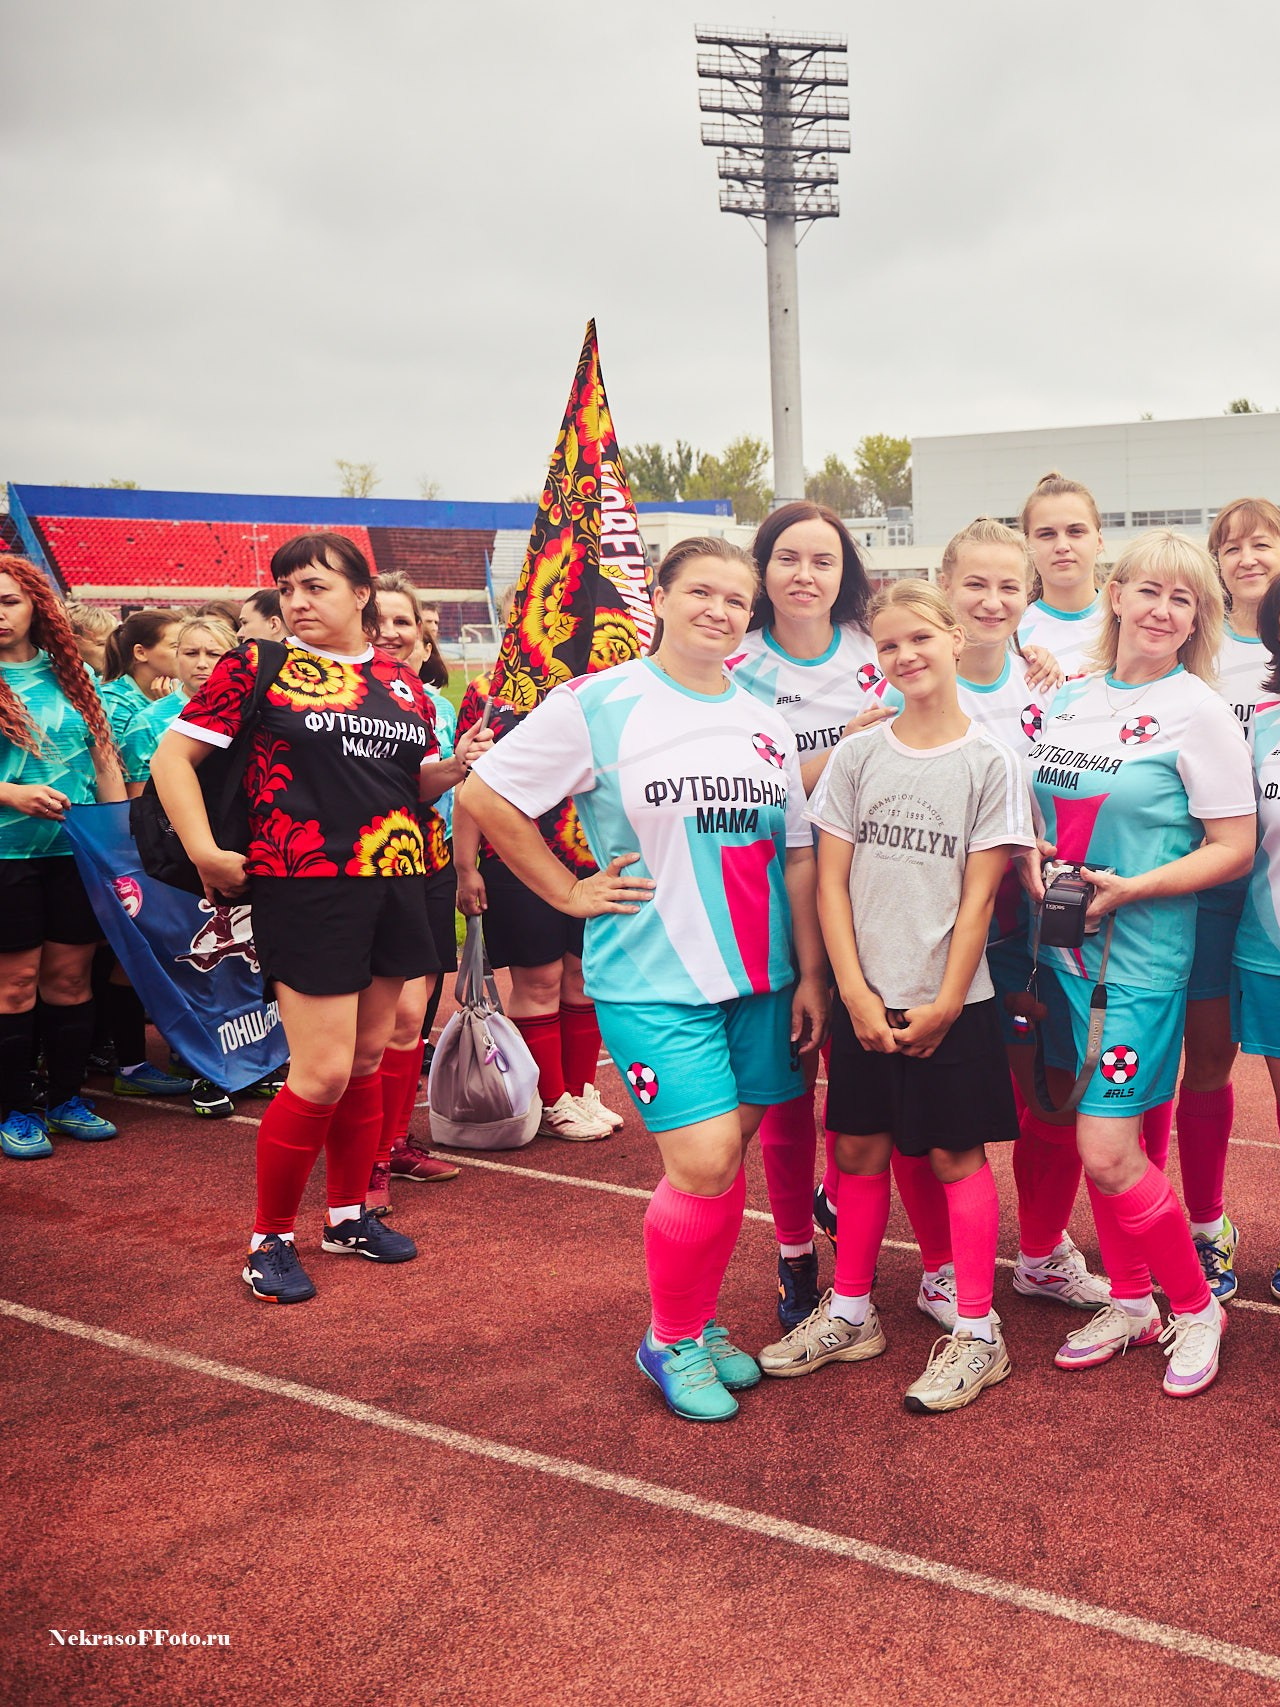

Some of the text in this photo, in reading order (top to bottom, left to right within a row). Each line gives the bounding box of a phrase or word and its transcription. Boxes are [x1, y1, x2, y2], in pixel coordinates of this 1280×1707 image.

[304, 711, 427, 747] ФУТБОЛЬНАЯ
[1028, 743, 1124, 775] ФУТБОЛЬНАЯ
[644, 776, 787, 813] ФУТБОЛЬНАЯ
[1036, 765, 1080, 790] МАМА
[696, 807, 759, 834] МАМА
[868, 793, 945, 827] CHAMPION LEAGUE
[857, 820, 958, 859] BROOKLYN
